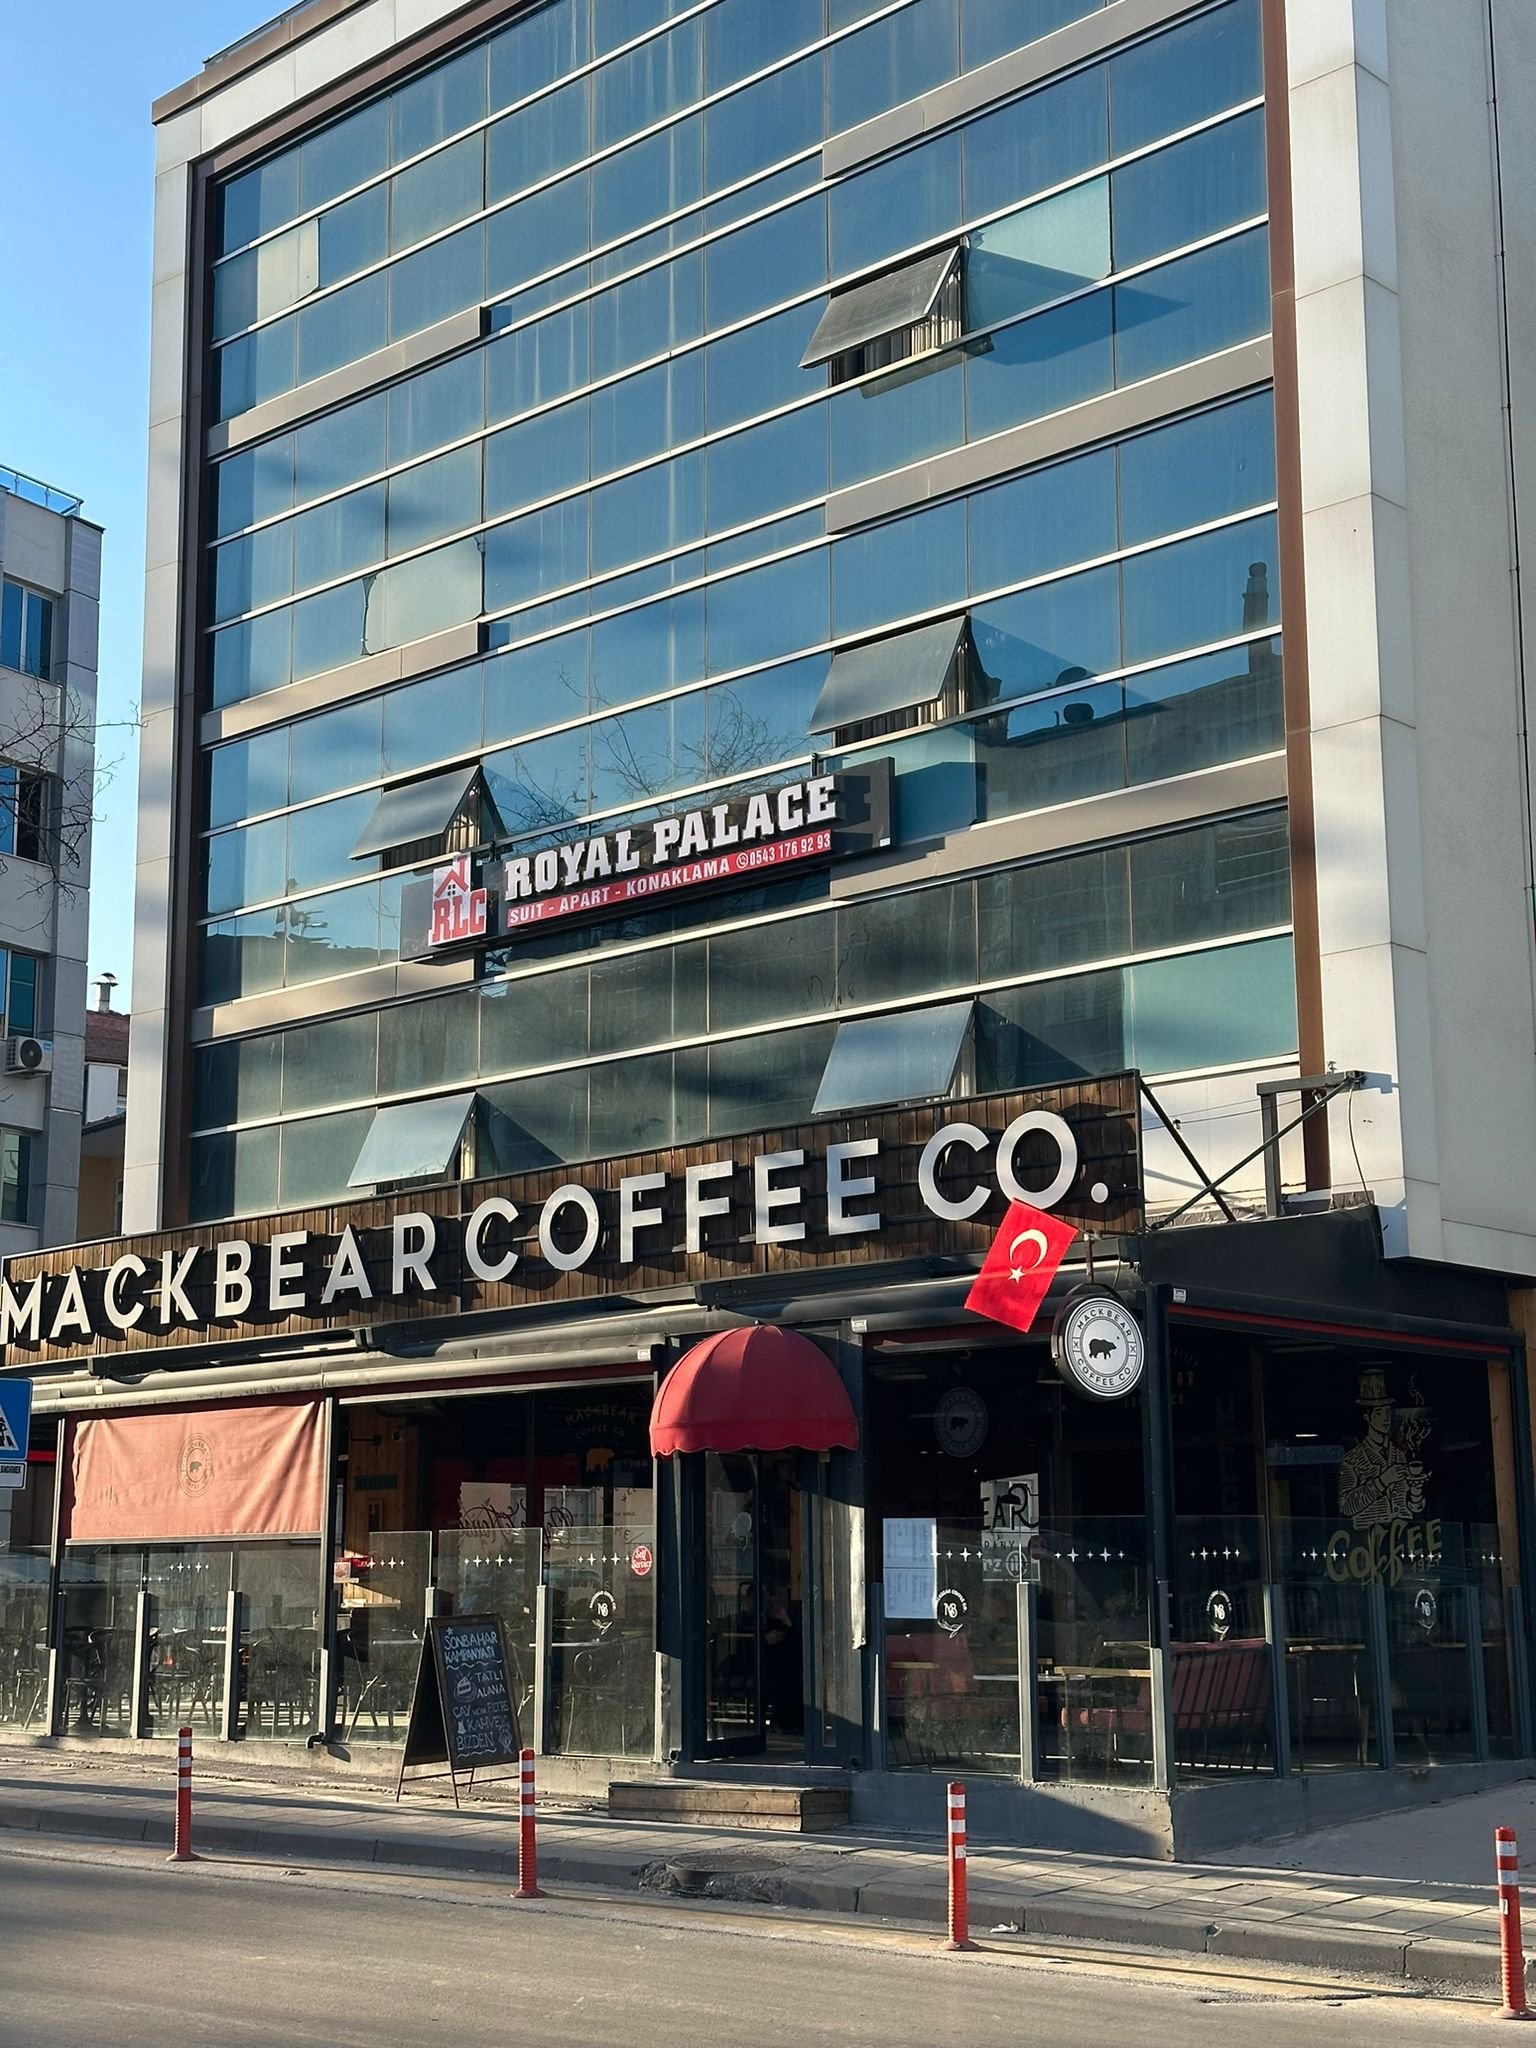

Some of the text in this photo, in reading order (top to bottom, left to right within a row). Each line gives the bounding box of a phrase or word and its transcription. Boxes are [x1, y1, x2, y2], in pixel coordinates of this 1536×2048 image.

[504, 775, 837, 901] ROYAL PALACE
[559, 886, 610, 913] APART
[626, 857, 730, 897] KONAKLAMA
[749, 847, 775, 866] 0543
[779, 841, 798, 859] 176
[801, 837, 814, 853] 92
[817, 833, 830, 849] 93
[430, 889, 487, 944] RLC
[0, 1109, 1109, 1344] MACKBEAR COFFEE CO.
[1077, 1308, 1132, 1336] MACKBEAR
[1077, 1358, 1115, 1386] COFFEE
[475, 1669, 504, 1683] TATLI
